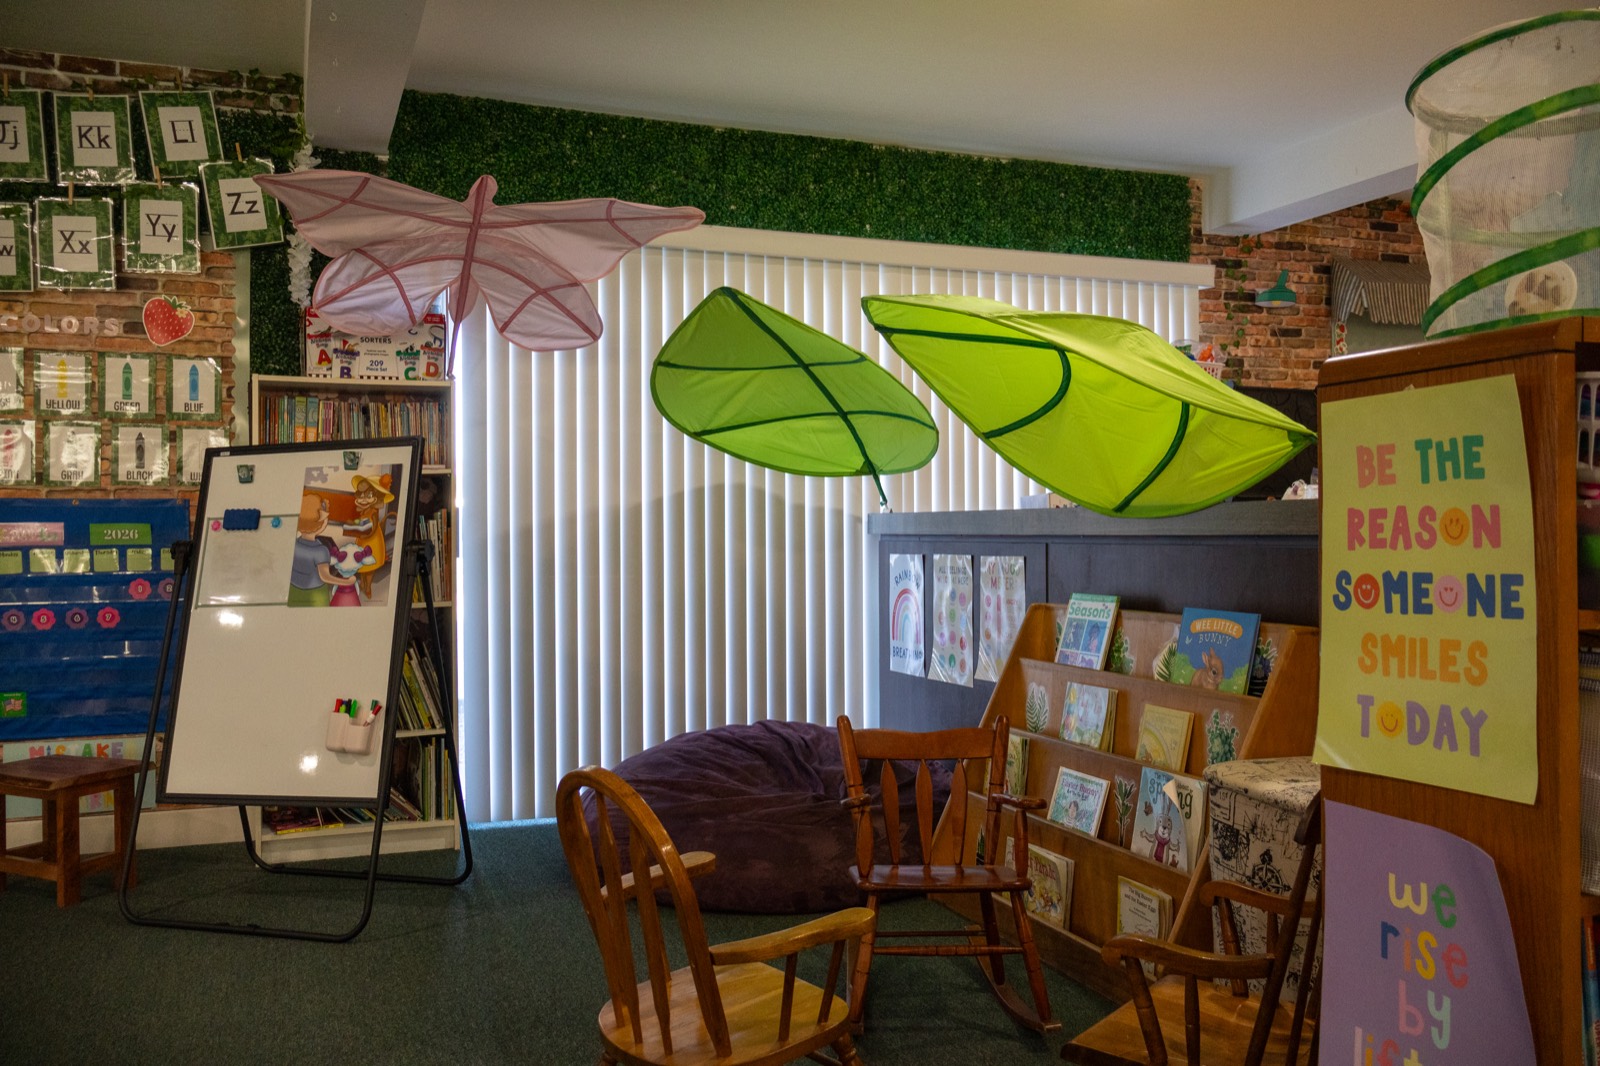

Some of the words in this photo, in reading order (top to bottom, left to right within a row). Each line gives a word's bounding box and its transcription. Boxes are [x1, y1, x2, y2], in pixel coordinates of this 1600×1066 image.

[0, 121, 18, 150] Jj
[78, 126, 112, 149] Kk
[171, 121, 196, 144] Ll
[227, 193, 260, 215] Zz
[145, 214, 176, 243] Yy
[0, 244, 13, 256] w
[60, 230, 91, 254] Xx
[0, 315, 119, 336] COLORS
[360, 336, 392, 345] SORTERS
[317, 348, 332, 365] A
[340, 366, 352, 379] B
[404, 367, 417, 380] C
[425, 361, 439, 377] D
[45, 400, 80, 409] YELLOW
[114, 401, 141, 411] GREEN
[184, 402, 204, 412] BLUE
[1356, 444, 1397, 488] BE
[1414, 434, 1486, 484] THE
[126, 470, 154, 480] BLACK
[104, 529, 139, 540] 2026
[1347, 504, 1501, 551] REASON
[1333, 570, 1524, 620] SOMEONE
[1069, 602, 1111, 619] Seasons
[1195, 619, 1211, 631] WEE
[1213, 620, 1239, 635] LITTLE
[1198, 633, 1232, 647] BUNNY
[892, 646, 923, 660] BREATING
[1358, 632, 1488, 687] SMILES
[1357, 694, 1488, 757] TODAY
[1149, 778, 1193, 819] Spng
[1388, 872, 1457, 928] we
[1381, 920, 1468, 989] rise
[1399, 979, 1450, 1050] by
